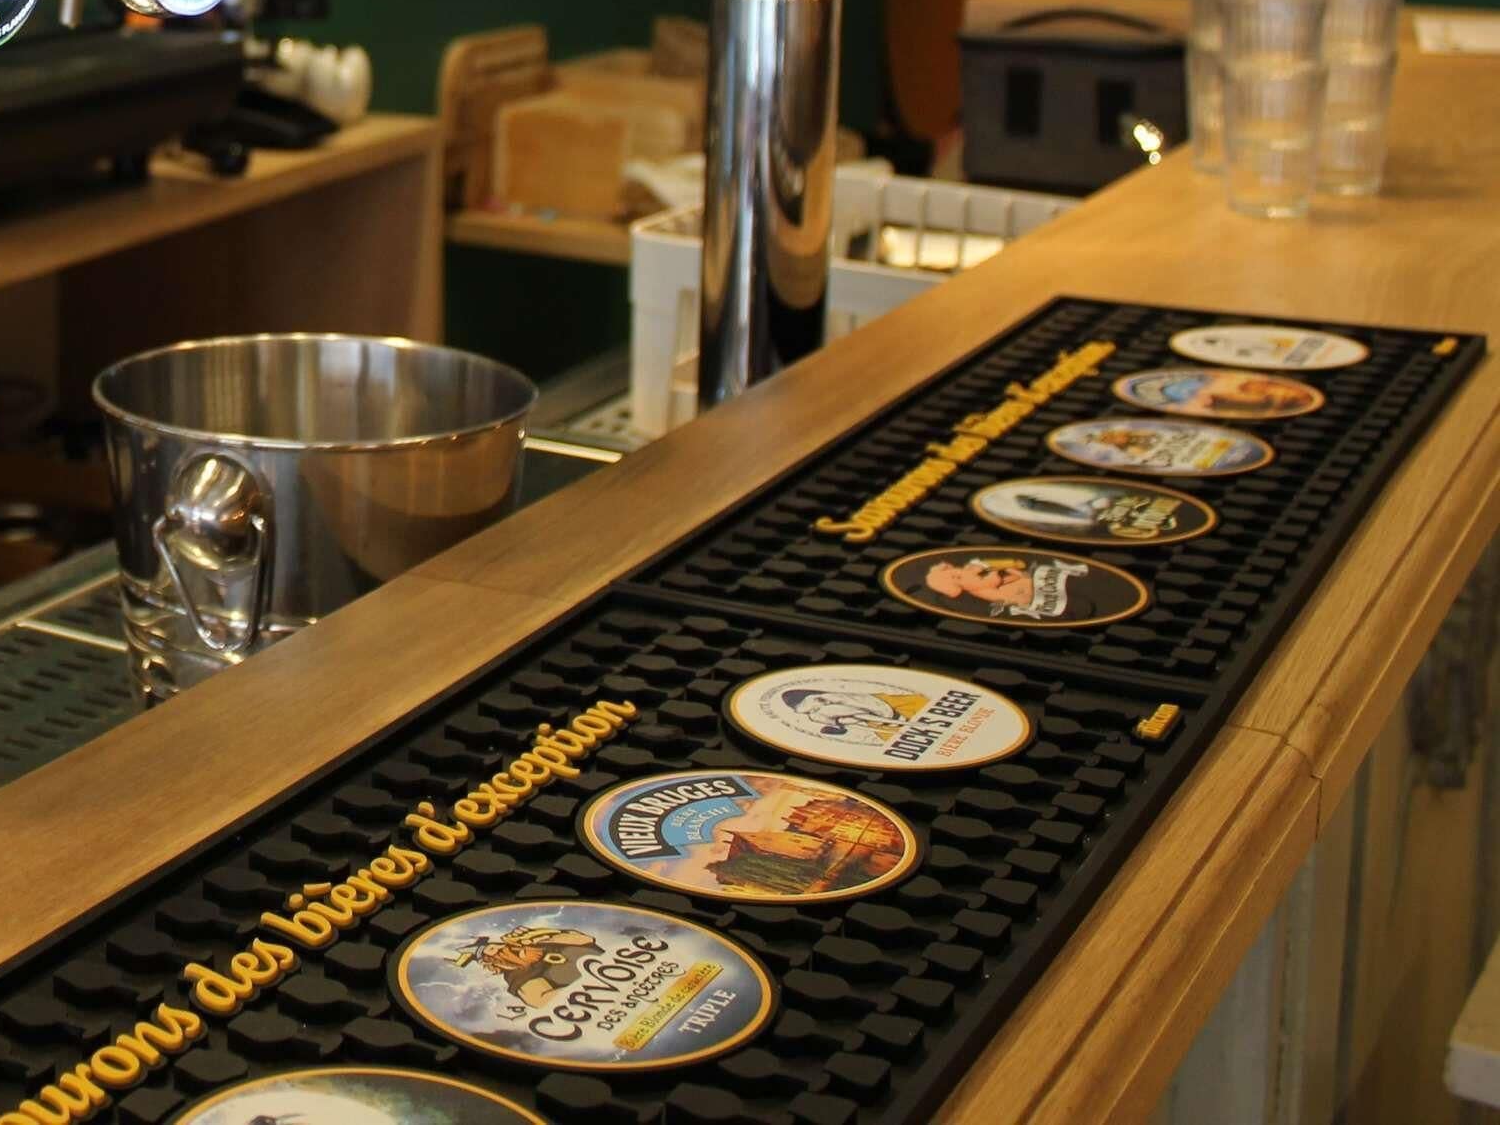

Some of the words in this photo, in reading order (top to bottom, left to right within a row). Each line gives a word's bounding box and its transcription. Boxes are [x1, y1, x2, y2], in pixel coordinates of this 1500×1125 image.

[927, 690, 982, 718] BEER
[625, 780, 736, 815] BRUGES
[618, 813, 662, 855] VIEUX
[186, 938, 294, 1014] des
[260, 844, 429, 946] bières
[406, 699, 637, 853] d'exception
[678, 989, 737, 1034] TRIPLE
